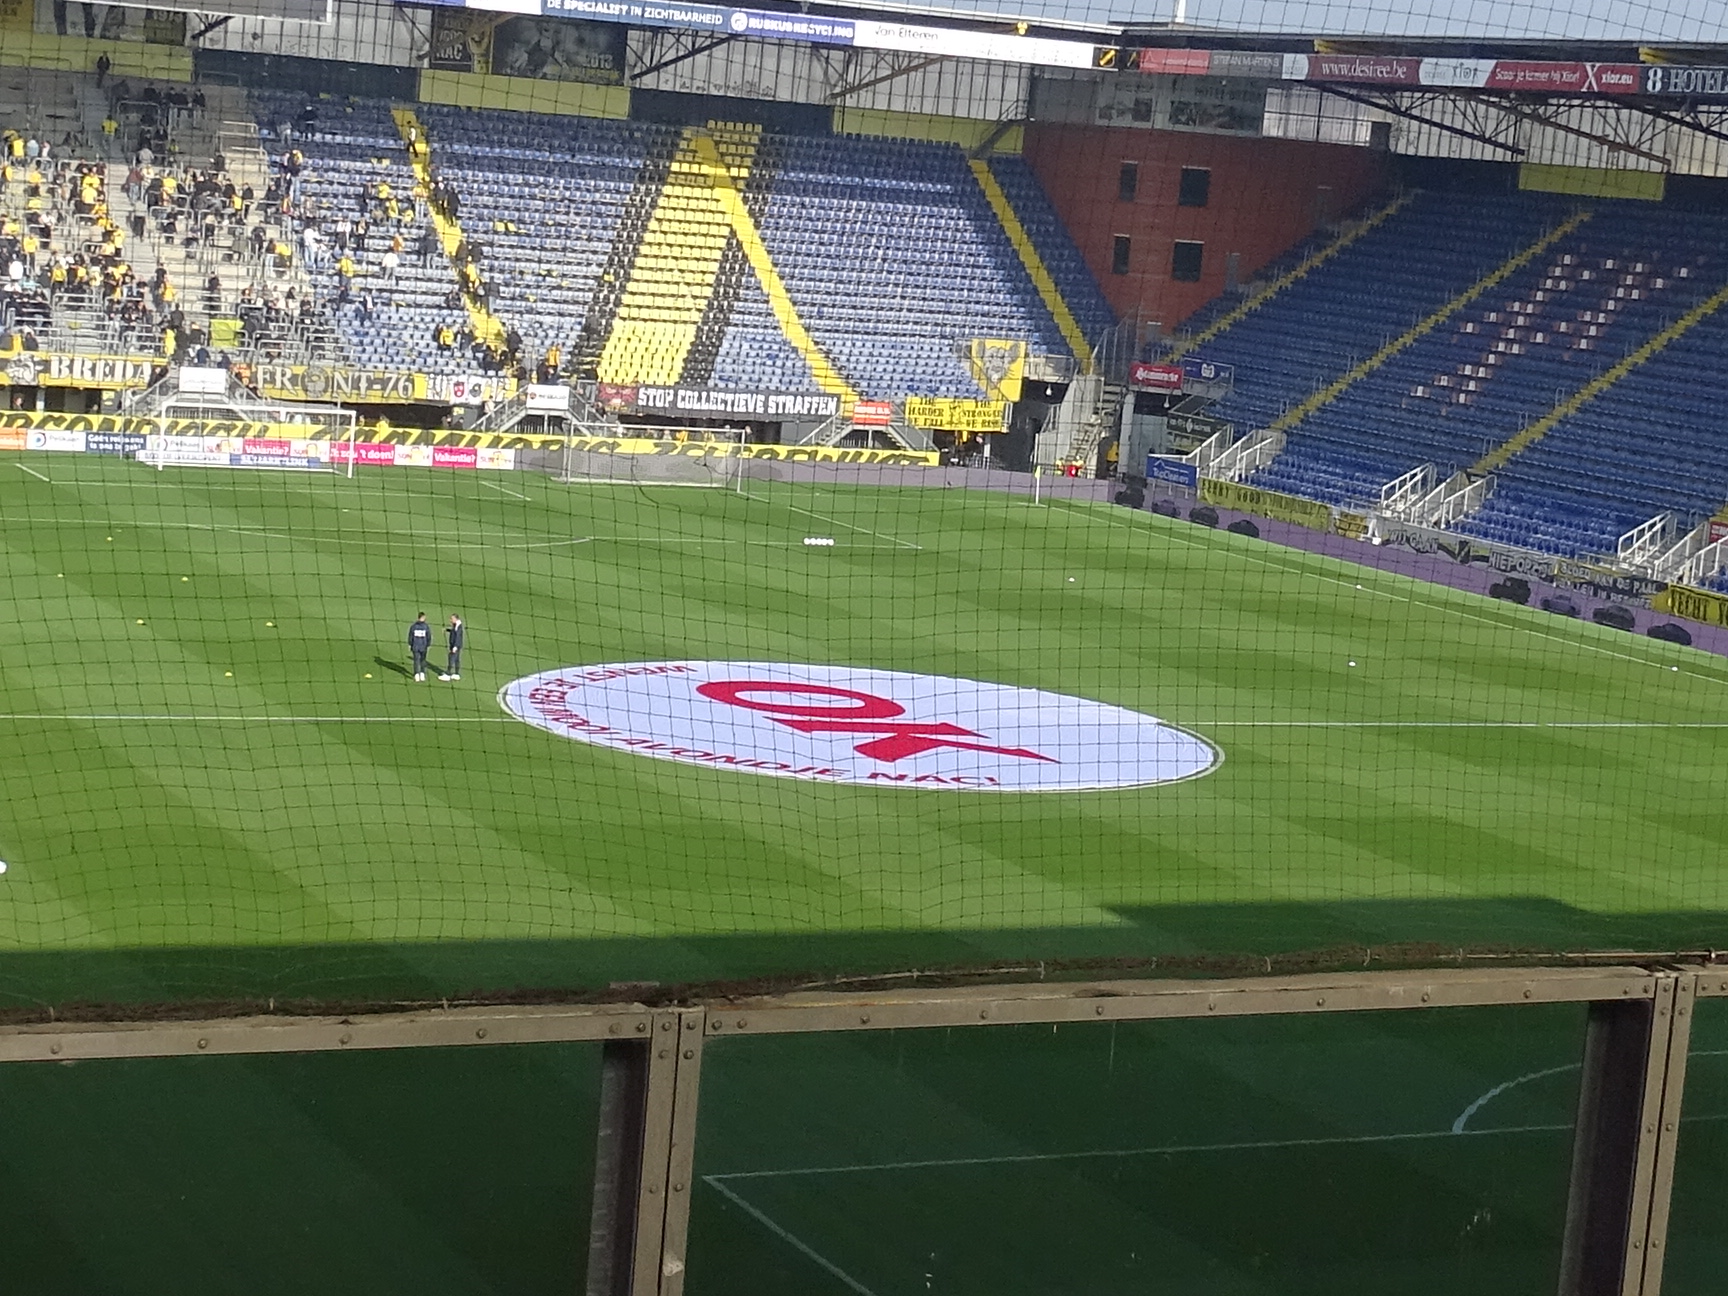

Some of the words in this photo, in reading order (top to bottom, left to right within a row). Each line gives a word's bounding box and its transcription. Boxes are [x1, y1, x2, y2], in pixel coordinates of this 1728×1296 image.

[563, 0, 629, 16] SPECIALIST
[630, 5, 641, 17] IN
[644, 7, 723, 26] ZICHTBAARHEID
[1321, 58, 1408, 79] www.desiree.be
[50, 356, 153, 385] BREDA
[638, 387, 673, 407] STOP
[676, 390, 766, 414] COLLECTIEVE
[767, 394, 838, 416] STRAFFEN
[908, 407, 945, 417] HARDER
[244, 444, 289, 455] Vakantie?
[434, 451, 476, 463] Vakantie?
[1488, 553, 1515, 573] NIET
[1632, 580, 1659, 595] PAAL
[604, 737, 856, 781] AVONDJE
[866, 766, 1003, 788] NAC!
